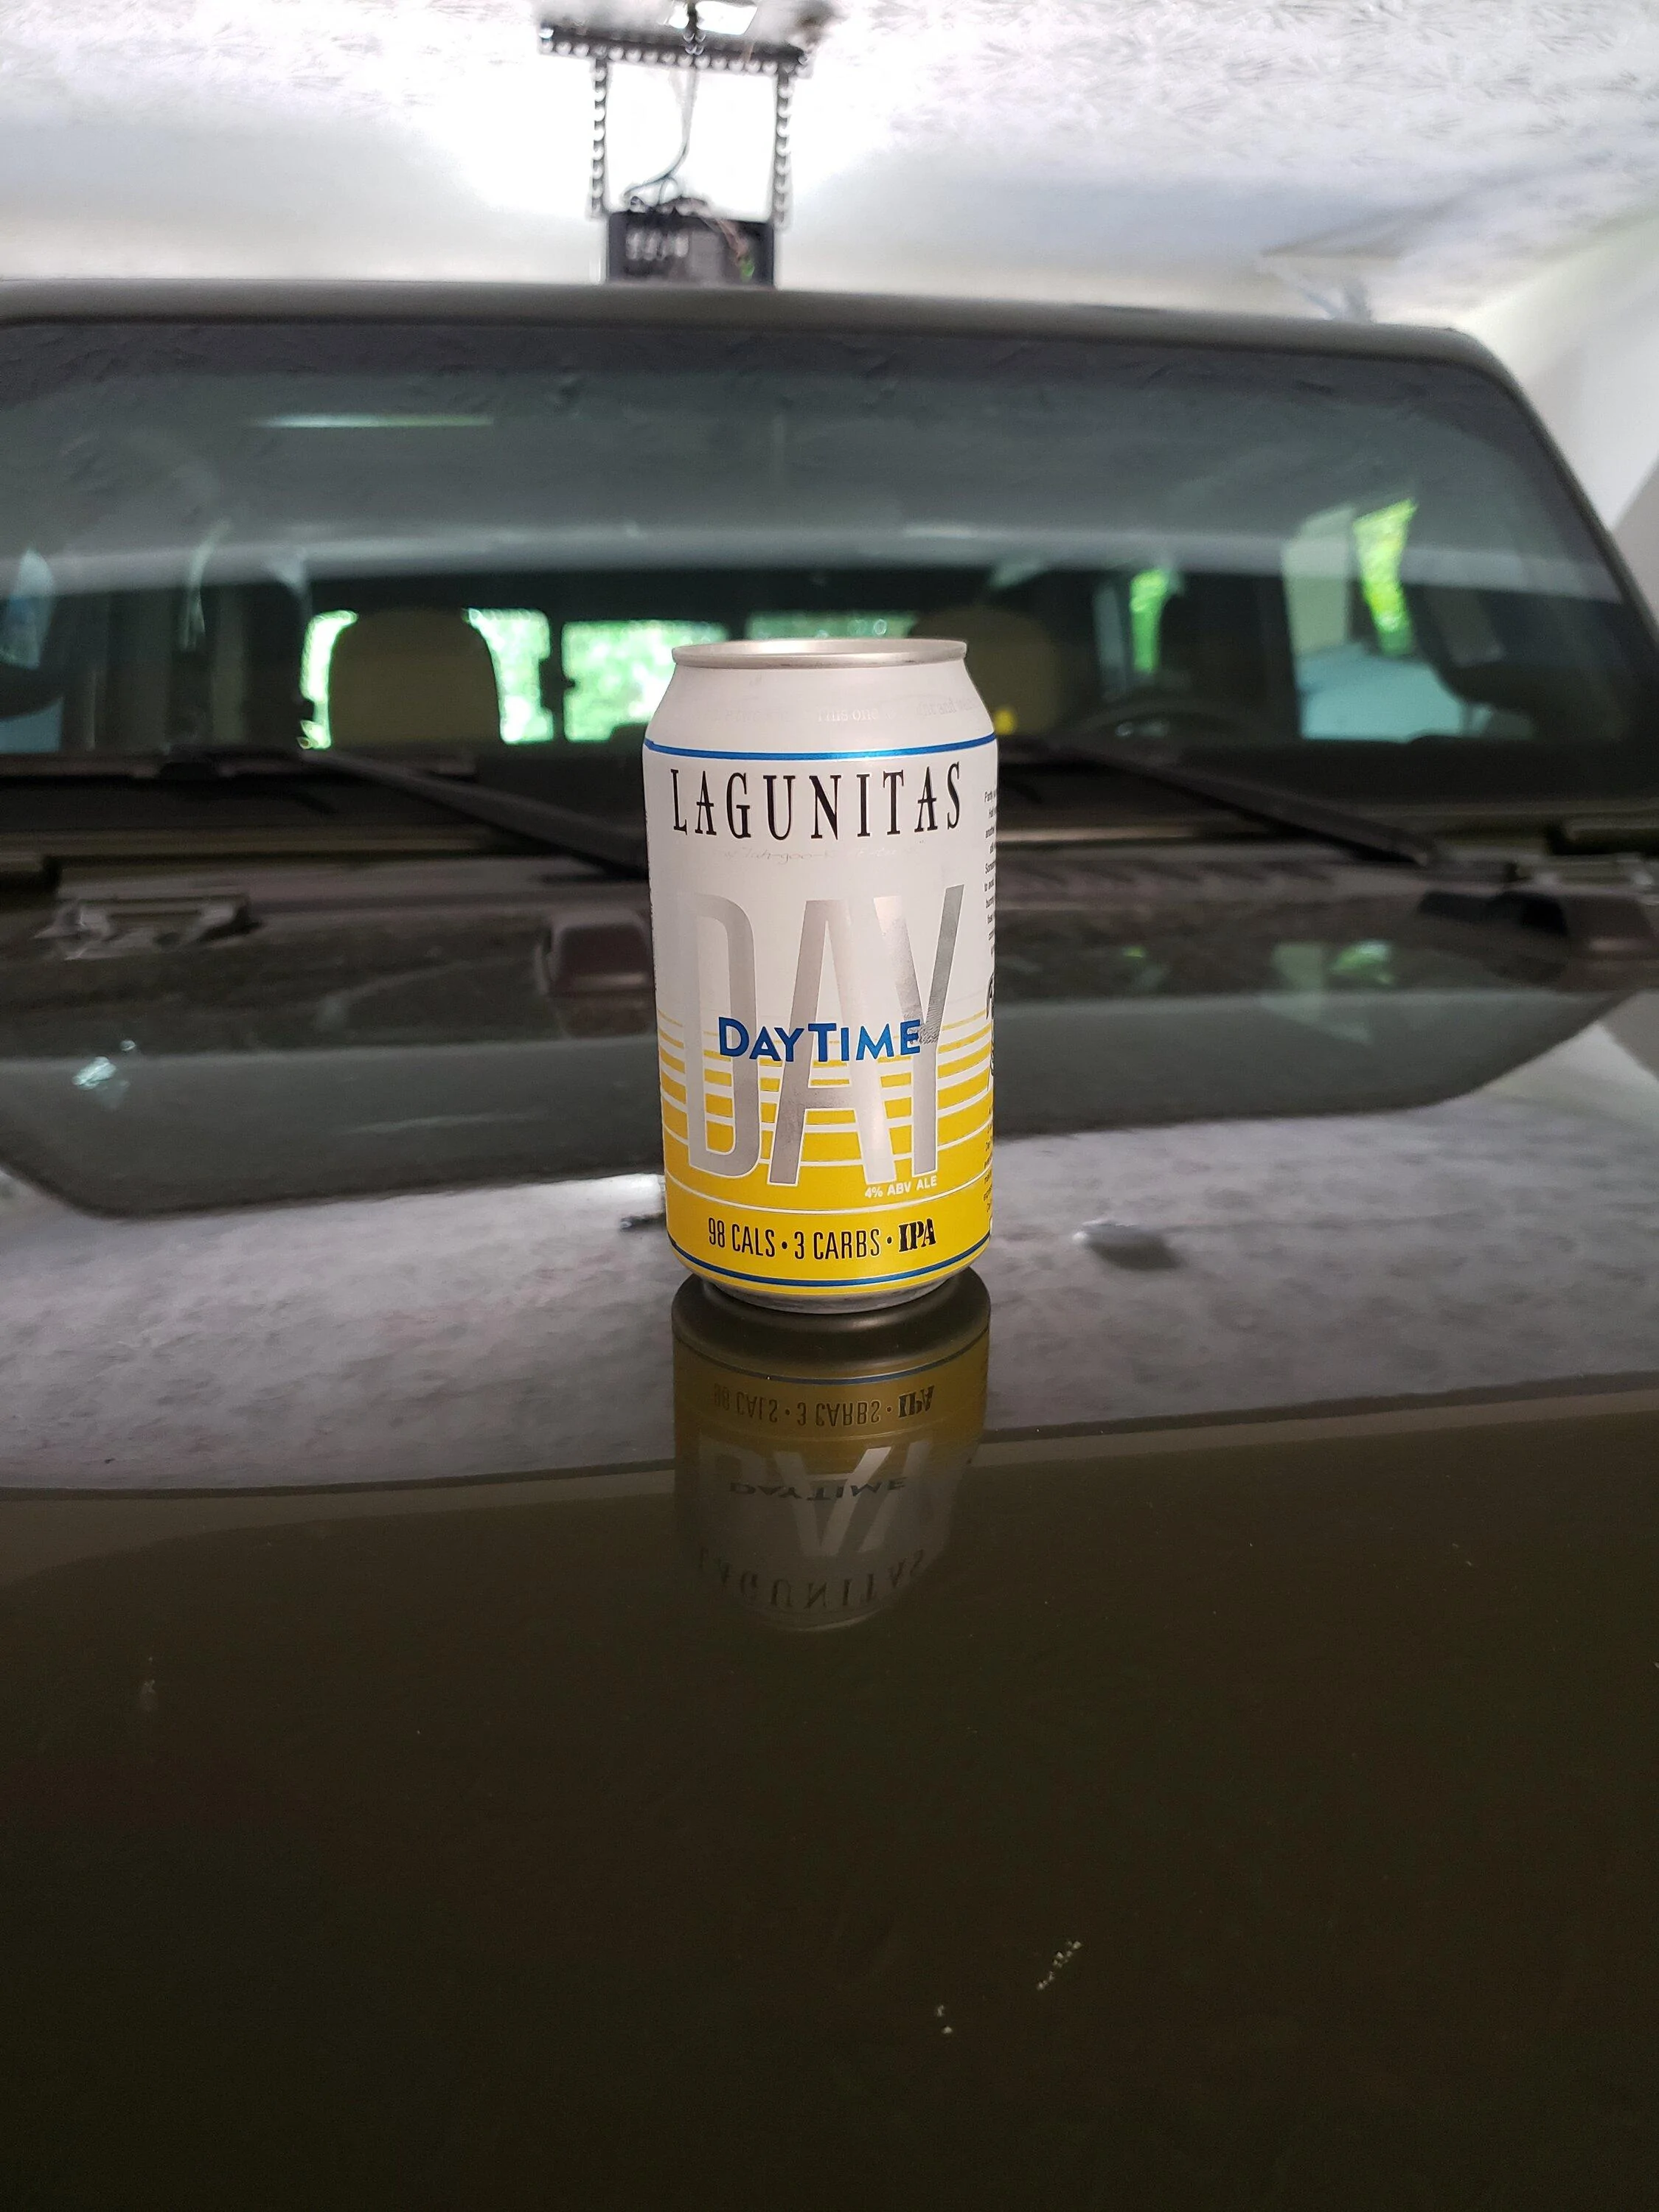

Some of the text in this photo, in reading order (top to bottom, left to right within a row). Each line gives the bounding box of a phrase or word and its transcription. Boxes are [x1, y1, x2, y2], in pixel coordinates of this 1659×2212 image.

[669, 761, 961, 841] LAGUNITAS
[678, 883, 965, 1187] DAY
[717, 1016, 922, 1062] DAYTIME
[864, 1175, 938, 1198] 4% ABV ALE
[708, 1217, 937, 1260] 98 CALS 3 CARBS IPA
